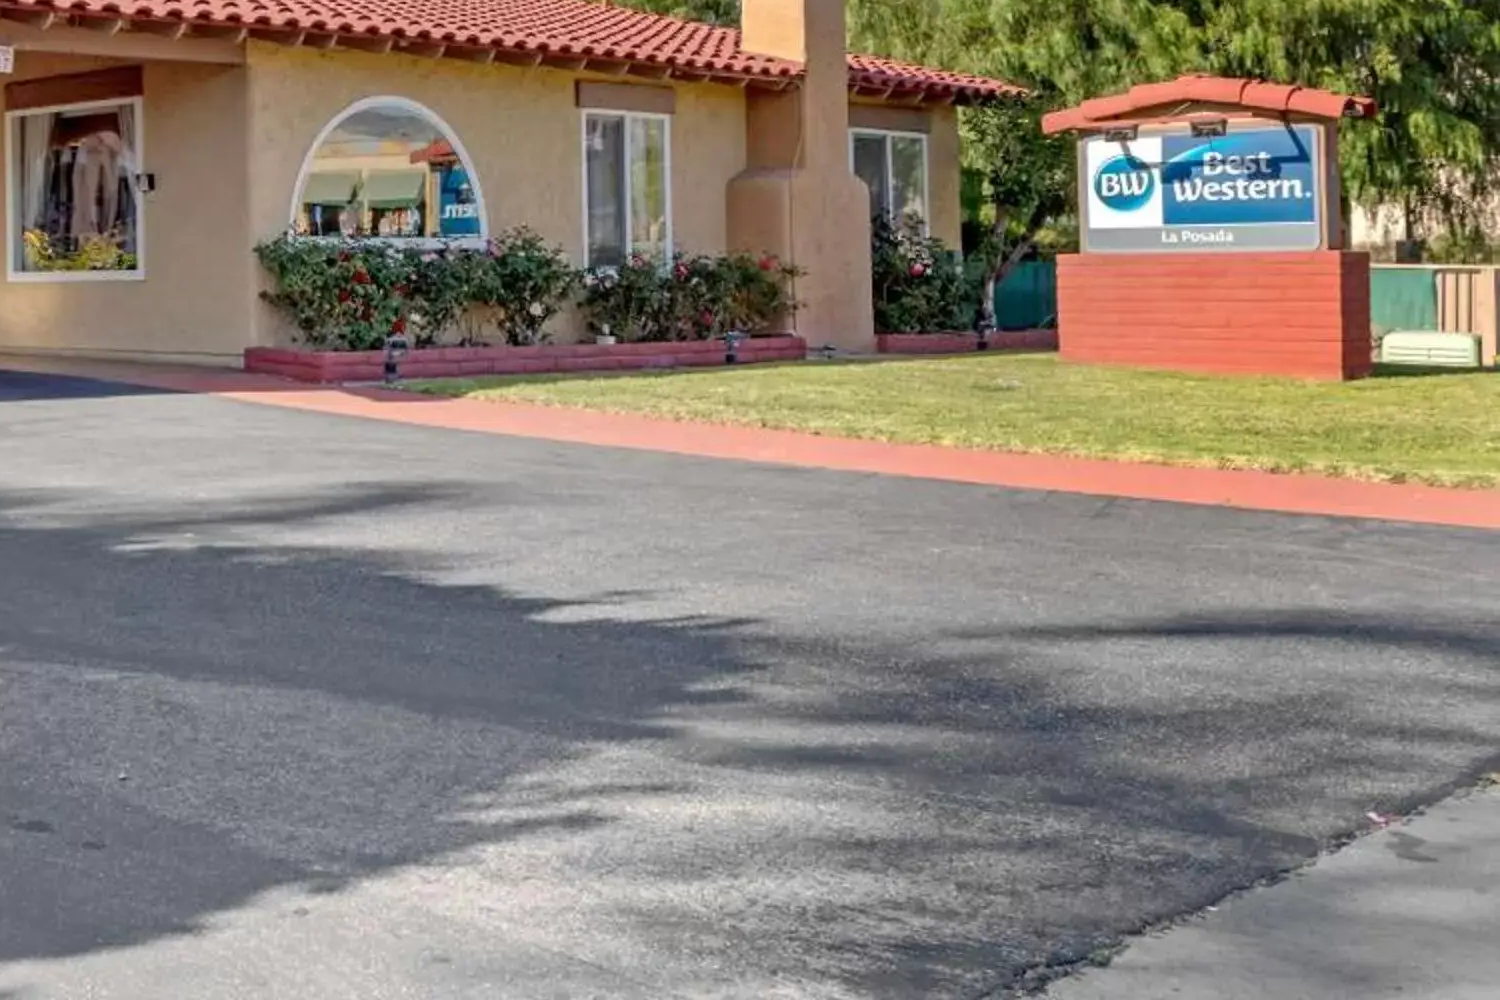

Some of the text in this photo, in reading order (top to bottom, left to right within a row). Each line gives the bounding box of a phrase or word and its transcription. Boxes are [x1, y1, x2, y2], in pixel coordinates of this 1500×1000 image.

[1203, 151, 1272, 175] Best
[1101, 173, 1148, 197] BW
[1161, 229, 1234, 243] La Posada
